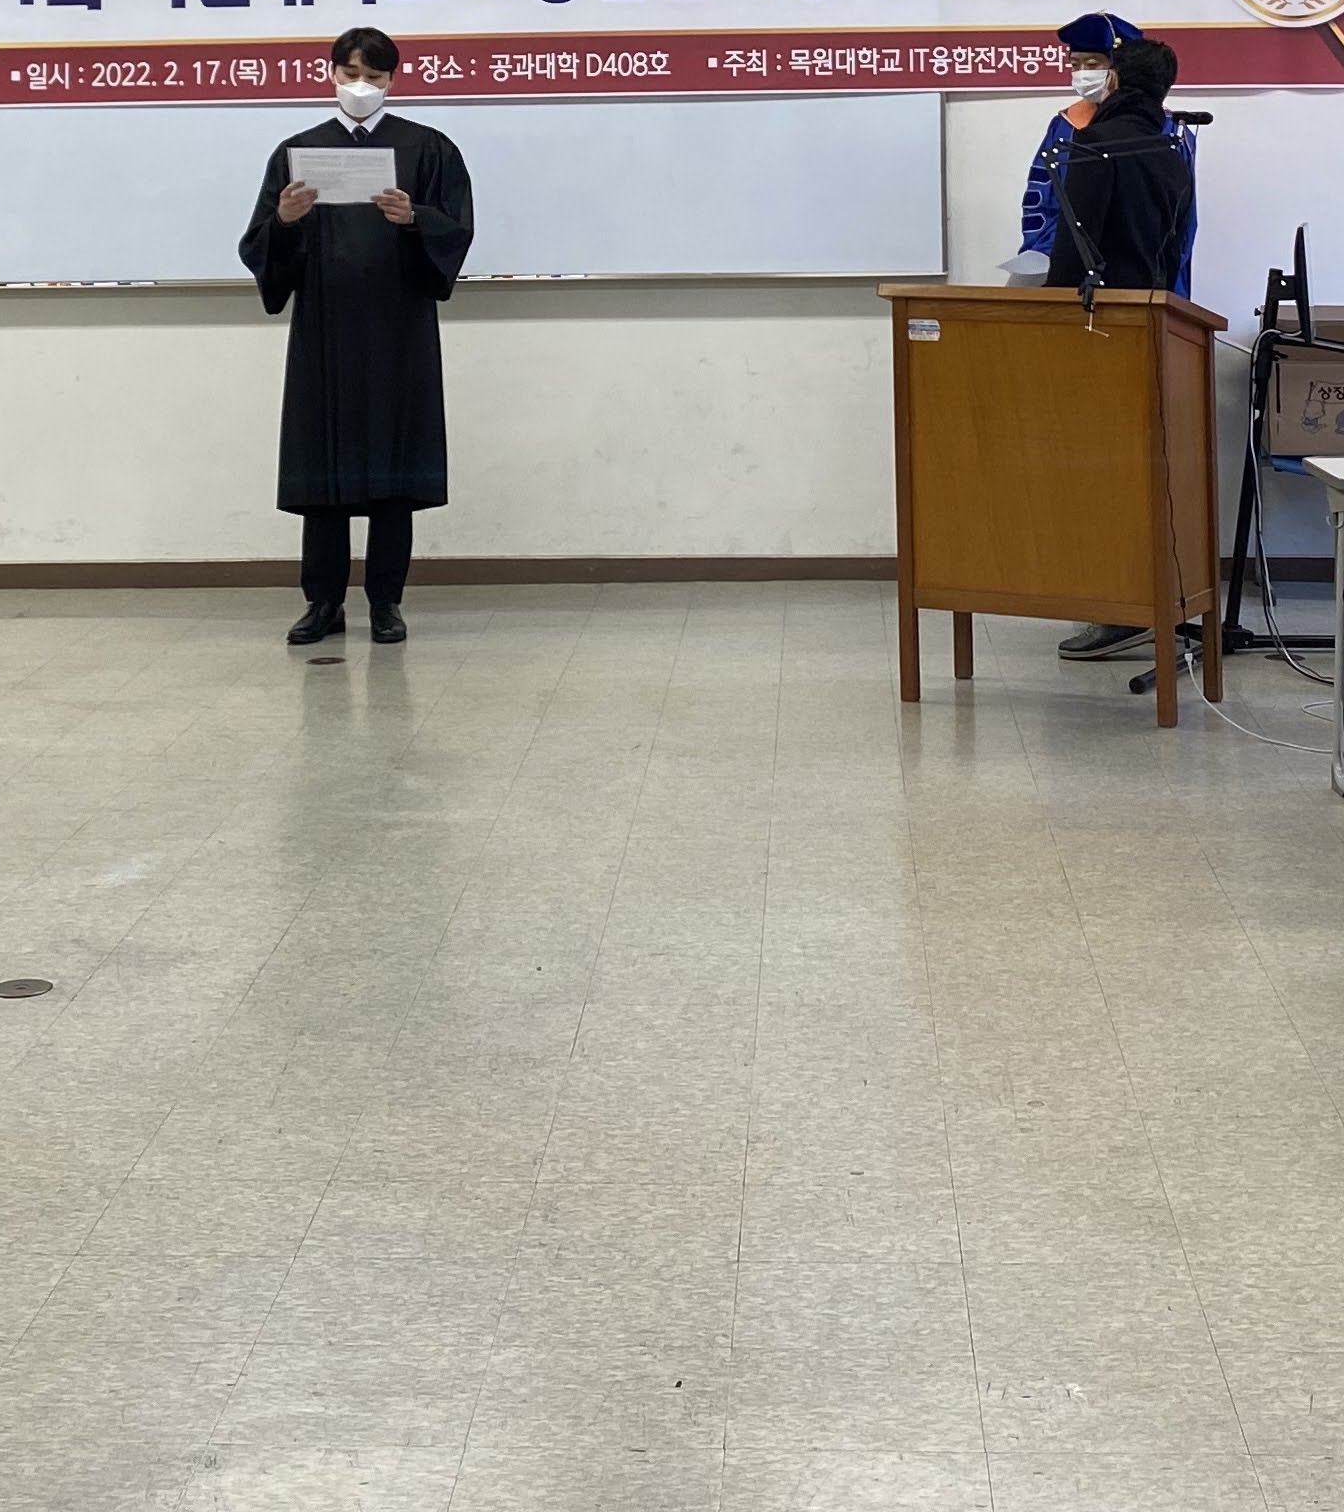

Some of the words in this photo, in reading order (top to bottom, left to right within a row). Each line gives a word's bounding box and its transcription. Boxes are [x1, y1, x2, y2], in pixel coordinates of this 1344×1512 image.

[26, 62, 70, 90] 일시
[91, 61, 157, 87] 2022.
[192, 58, 267, 87] 17.(목)
[417, 54, 464, 83] 장소
[488, 51, 581, 82] 공과대학
[586, 50, 672, 77] D408호
[722, 49, 767, 77] 주최
[788, 46, 904, 76] 목원대학교
